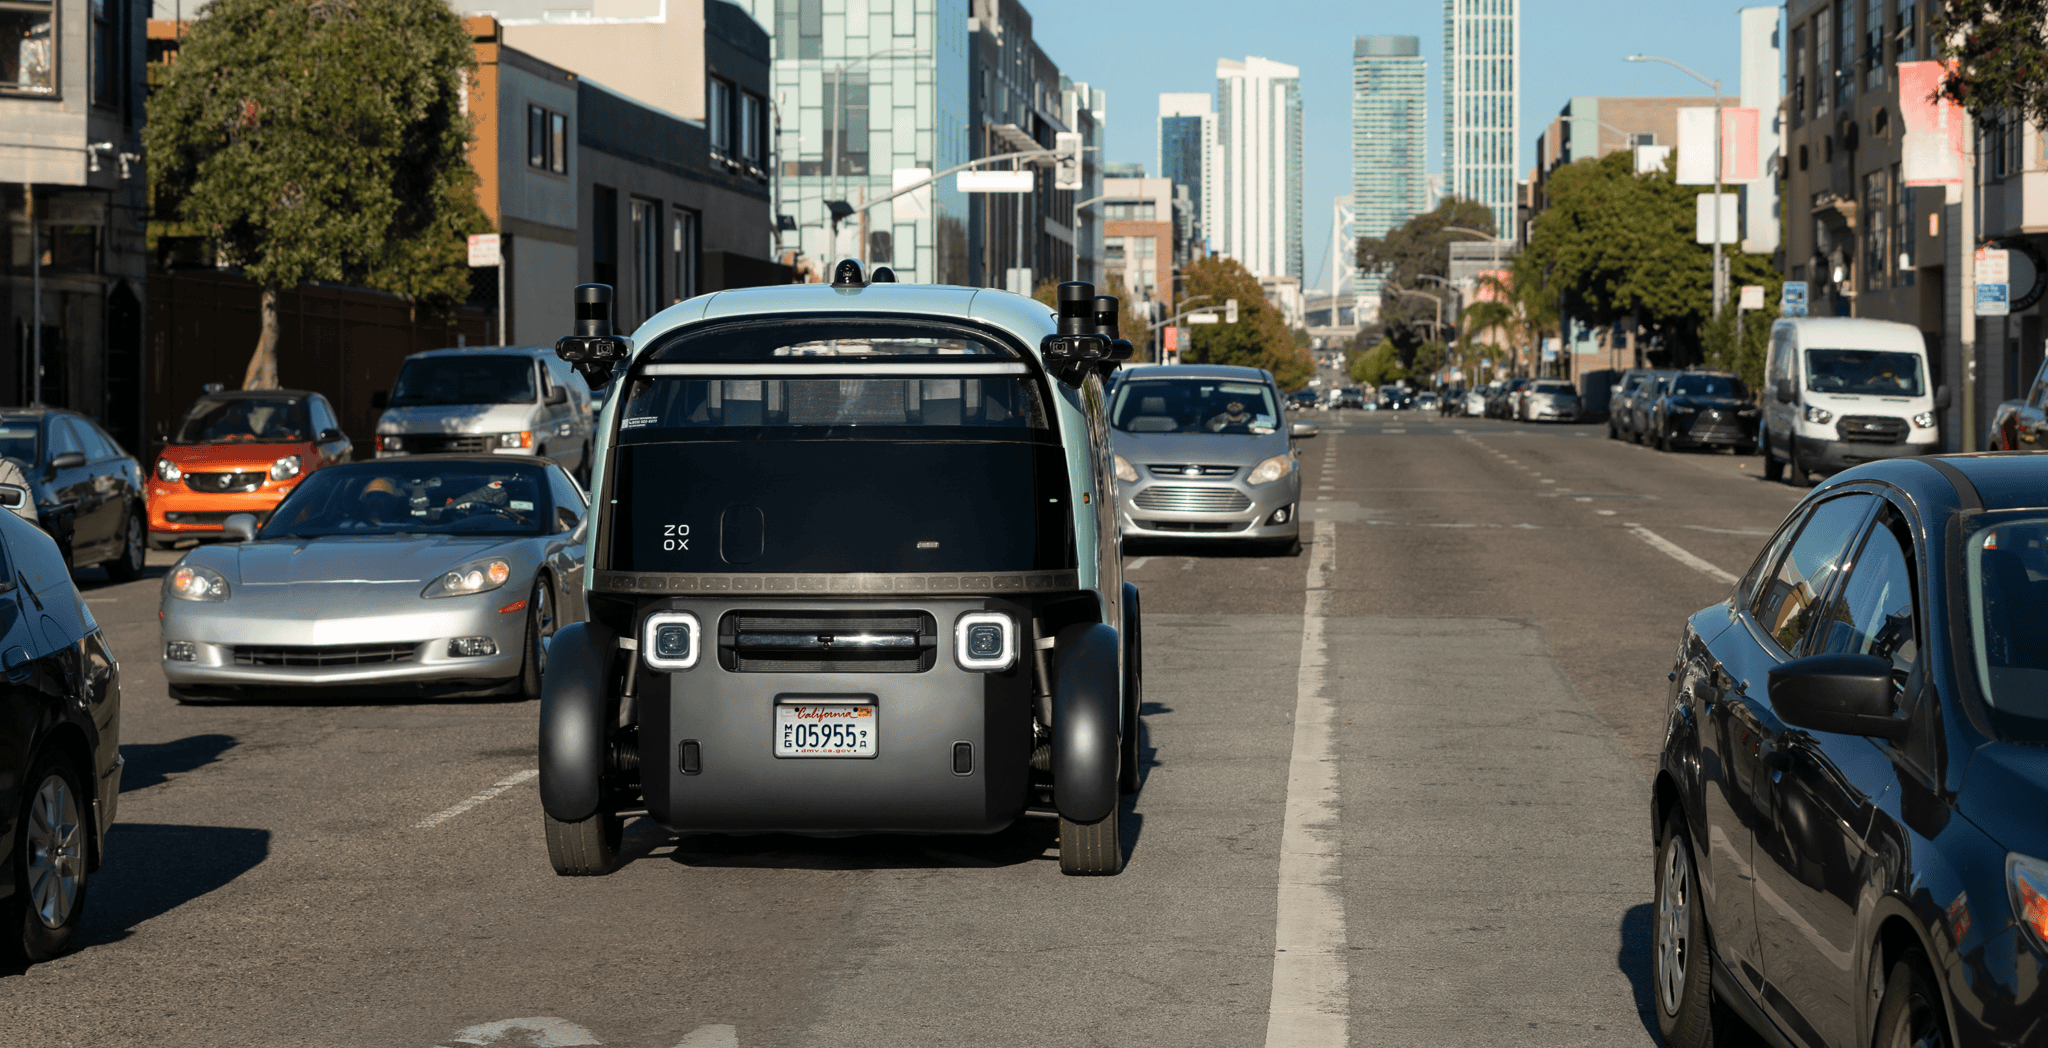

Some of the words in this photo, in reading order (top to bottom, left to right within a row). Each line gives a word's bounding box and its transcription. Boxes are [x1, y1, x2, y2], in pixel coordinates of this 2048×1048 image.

[664, 524, 690, 536] ZO
[663, 539, 690, 551] OX
[797, 707, 858, 722] California
[784, 724, 792, 747] MFG
[795, 724, 856, 747] 05955
